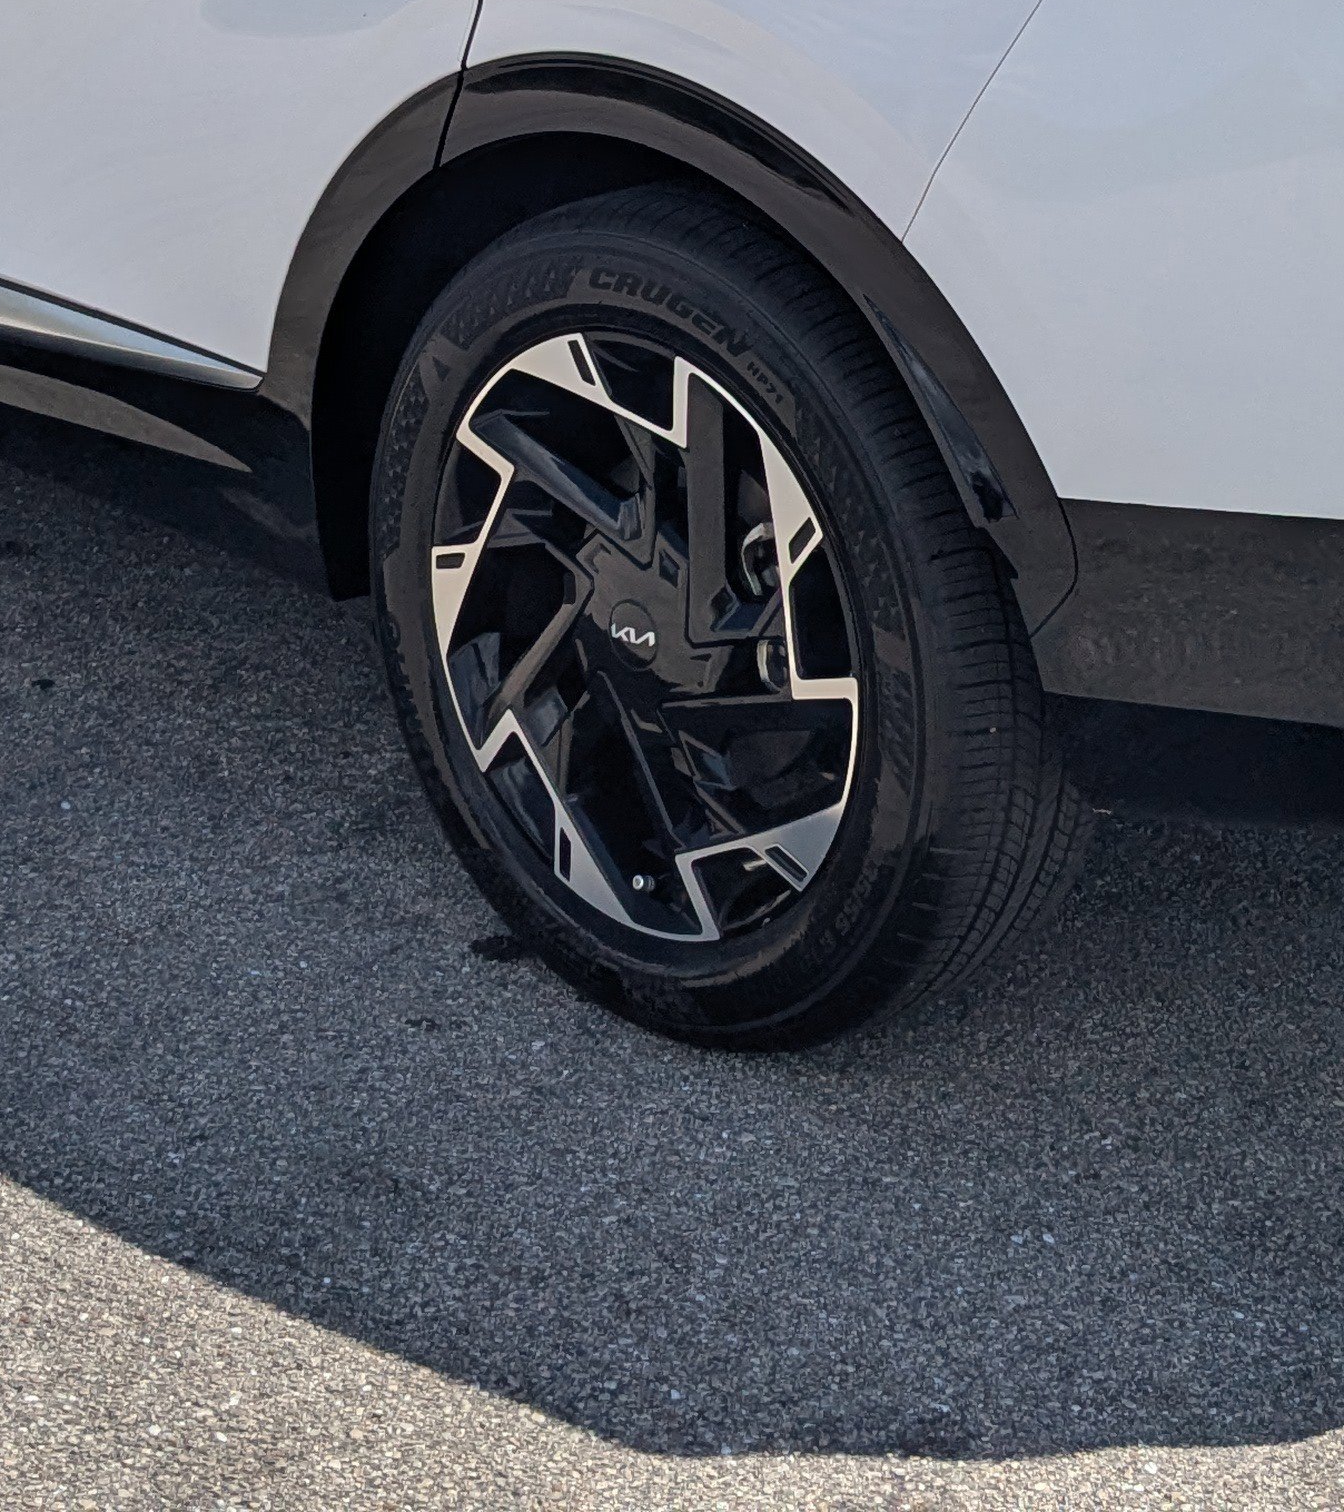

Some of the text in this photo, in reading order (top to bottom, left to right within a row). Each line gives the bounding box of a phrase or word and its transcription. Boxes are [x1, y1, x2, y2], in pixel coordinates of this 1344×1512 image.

[588, 268, 753, 357] CRUGEN
[746, 360, 784, 404] HP71
[610, 622, 656, 647] KIA
